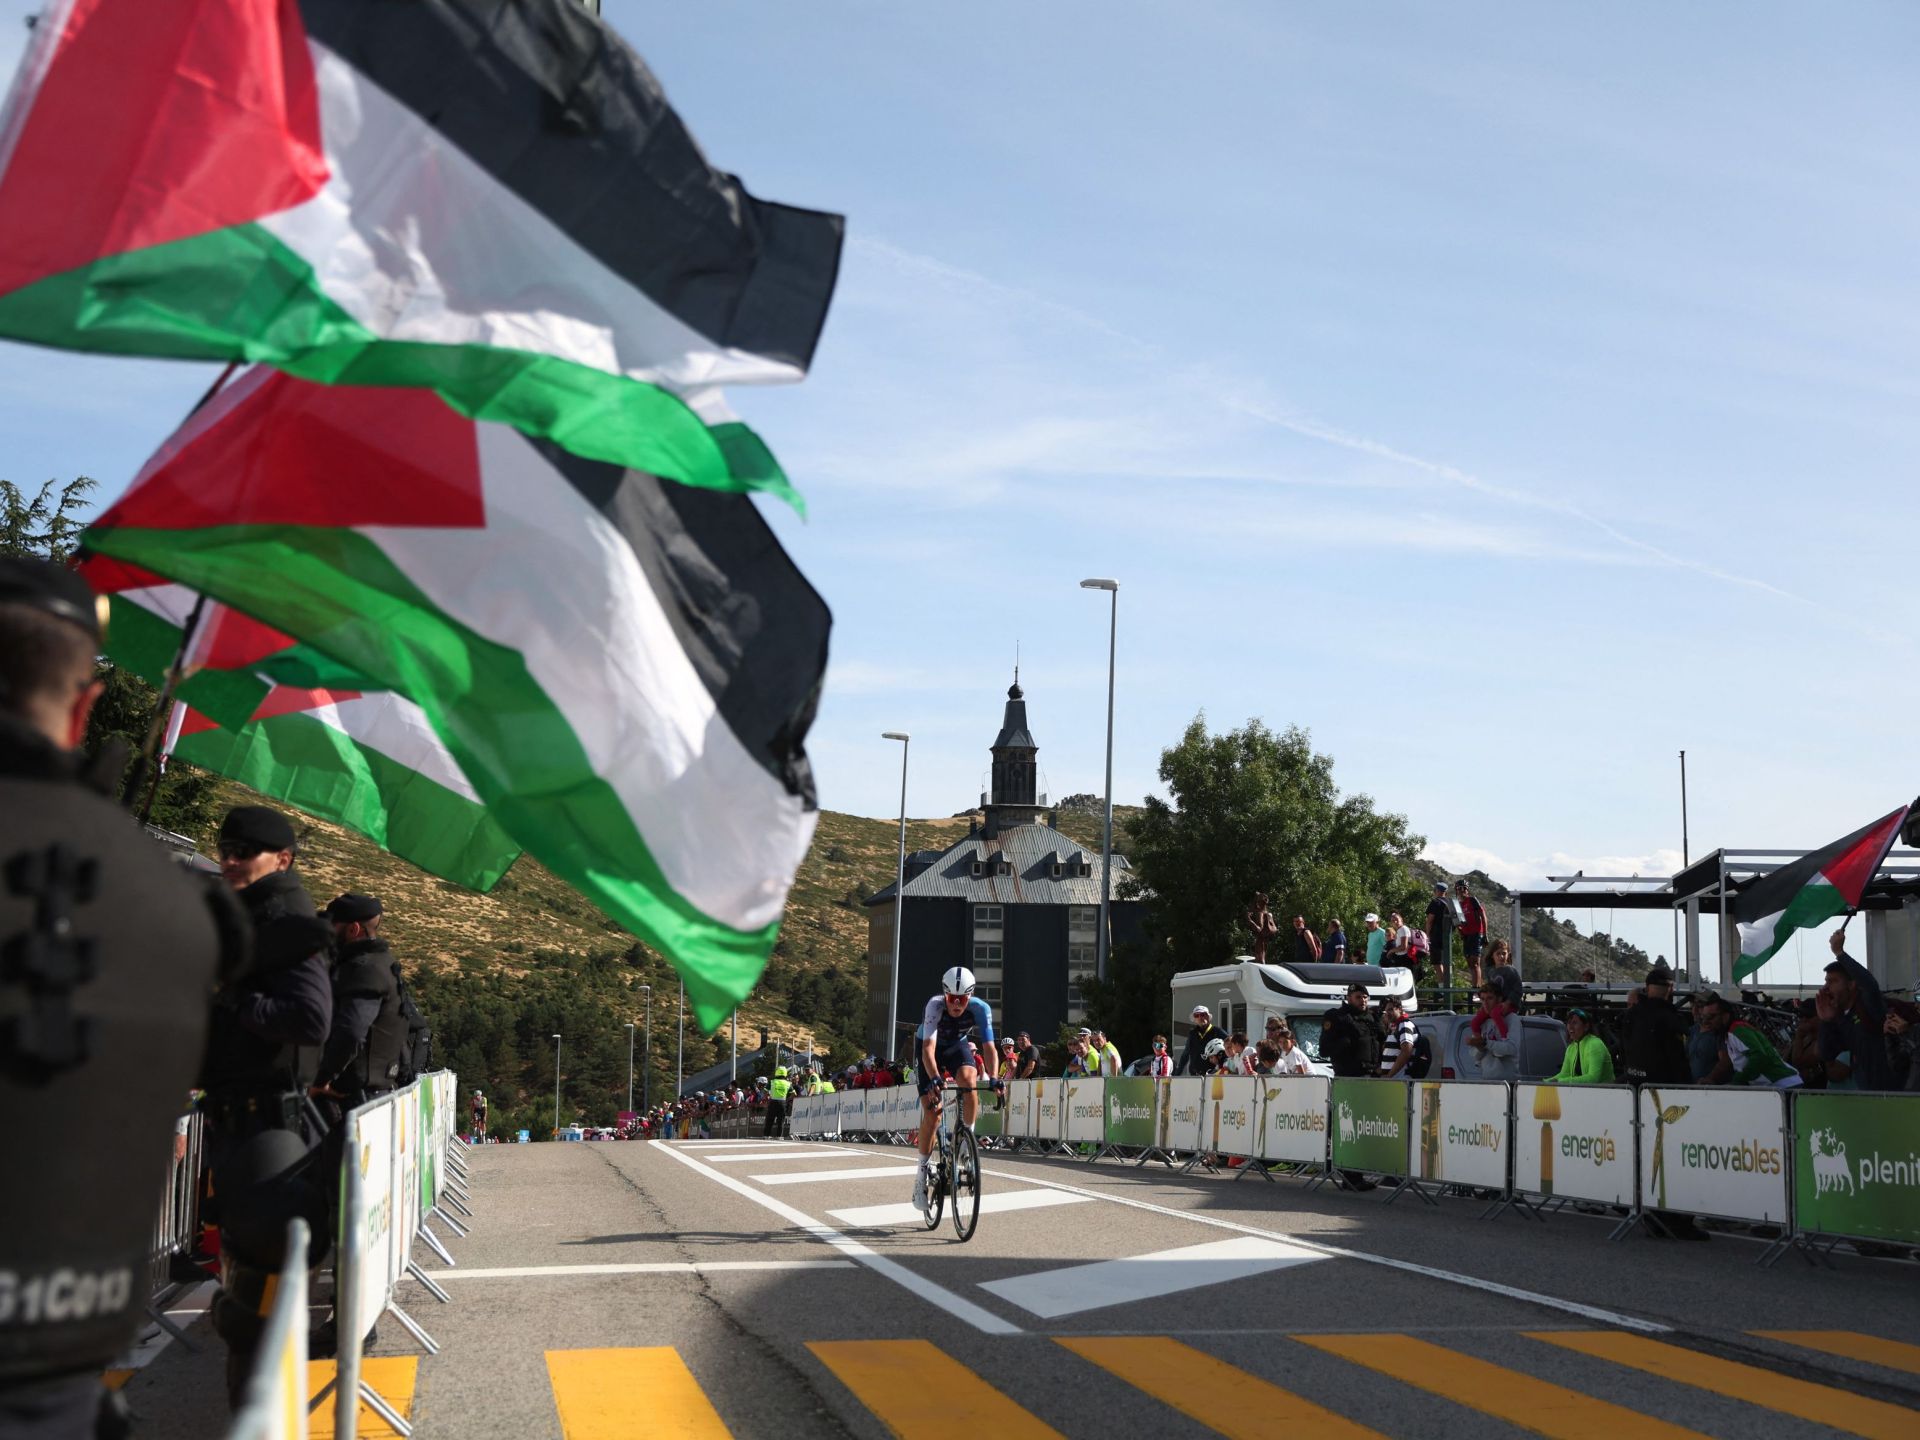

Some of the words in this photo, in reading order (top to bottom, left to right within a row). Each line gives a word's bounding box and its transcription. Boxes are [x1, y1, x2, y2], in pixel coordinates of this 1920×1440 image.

[1074, 1102, 1102, 1118] renovables
[1122, 1103, 1150, 1121] plenitude
[1173, 1105, 1198, 1126] e-mobility
[1222, 1105, 1246, 1130] energía
[1275, 1109, 1325, 1132] renovables
[1356, 1115, 1399, 1138] plenitude
[1448, 1123, 1501, 1153] e-mobility
[1561, 1129, 1616, 1167] energía
[1681, 1138, 1781, 1175] renovables
